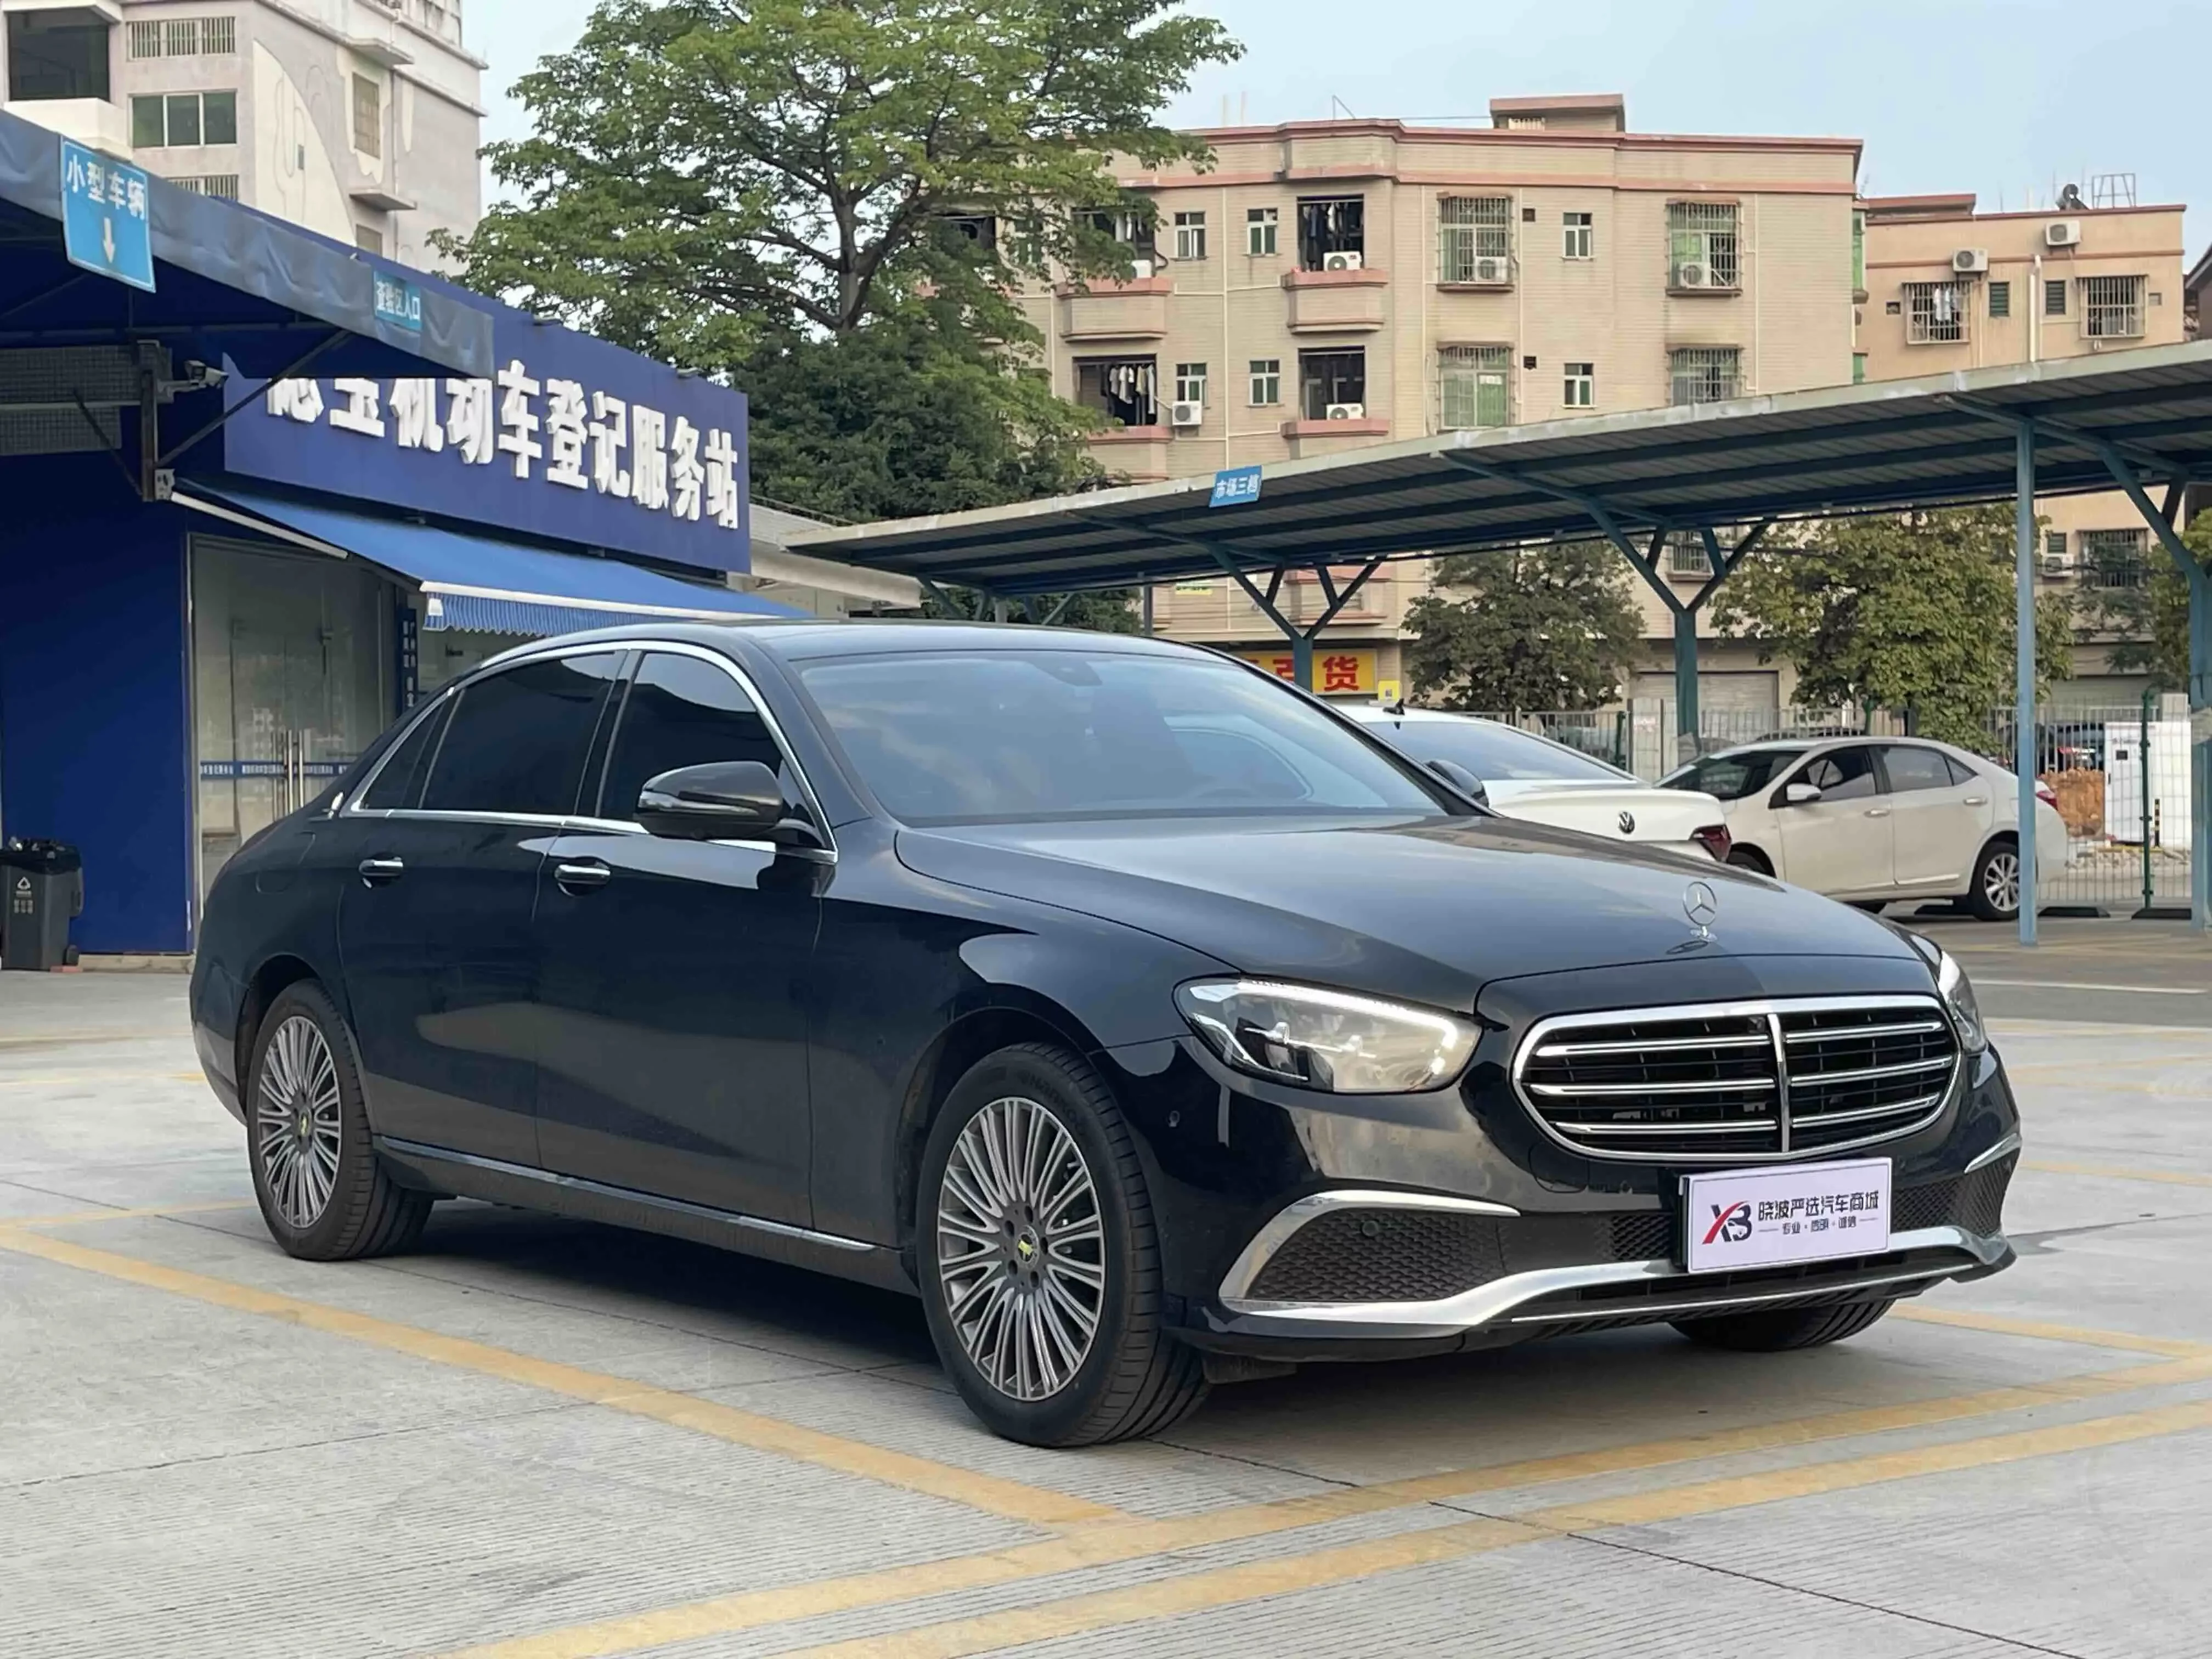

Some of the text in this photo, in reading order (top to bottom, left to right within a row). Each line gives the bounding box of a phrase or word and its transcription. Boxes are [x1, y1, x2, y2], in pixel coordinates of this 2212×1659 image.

[66, 154, 145, 221] 小型车辆
[1758, 1189, 1879, 1221] 晓波严选汽车商城
